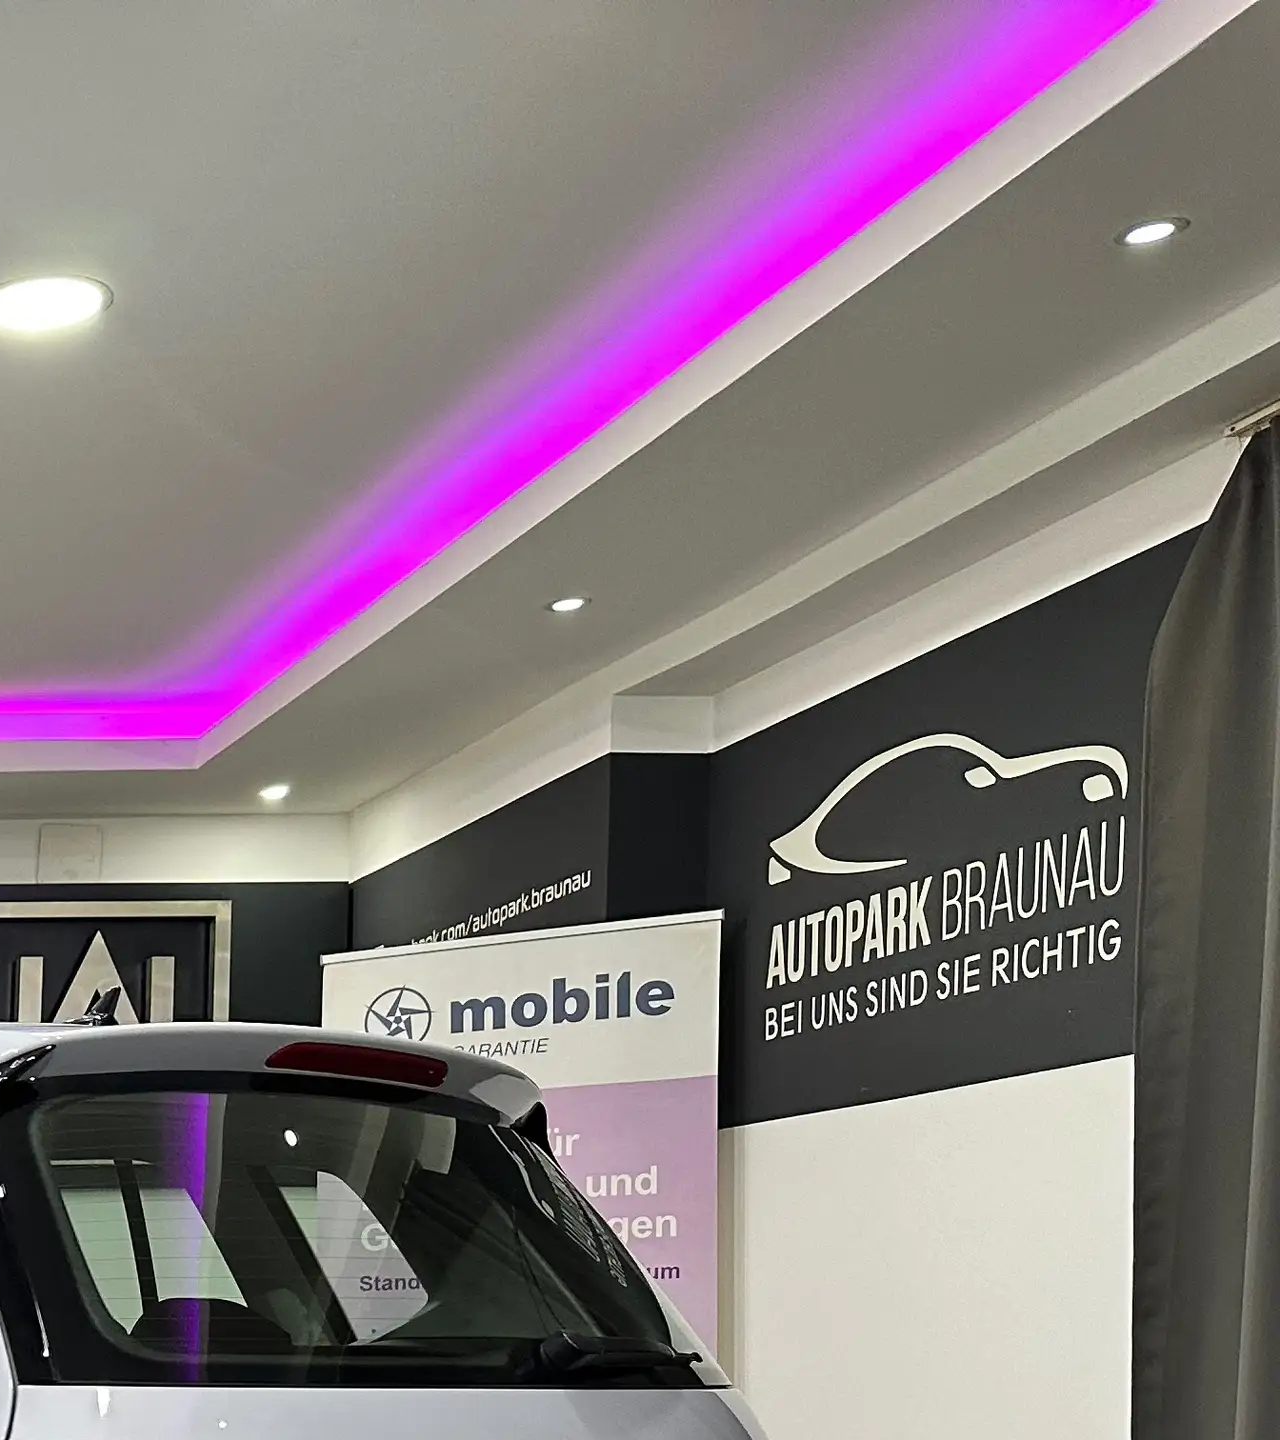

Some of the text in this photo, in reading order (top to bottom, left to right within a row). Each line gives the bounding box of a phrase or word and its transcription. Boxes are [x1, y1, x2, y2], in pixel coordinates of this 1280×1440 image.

[766, 815, 1126, 990] AUTOPARK BRAUNAU
[449, 970, 676, 1034] mobile
[765, 918, 1122, 1041] BEI UNS SIND SIE RICHTIG
[454, 1037, 550, 1058] ARANTIE
[547, 1127, 580, 1157] ür
[585, 1165, 658, 1198] und
